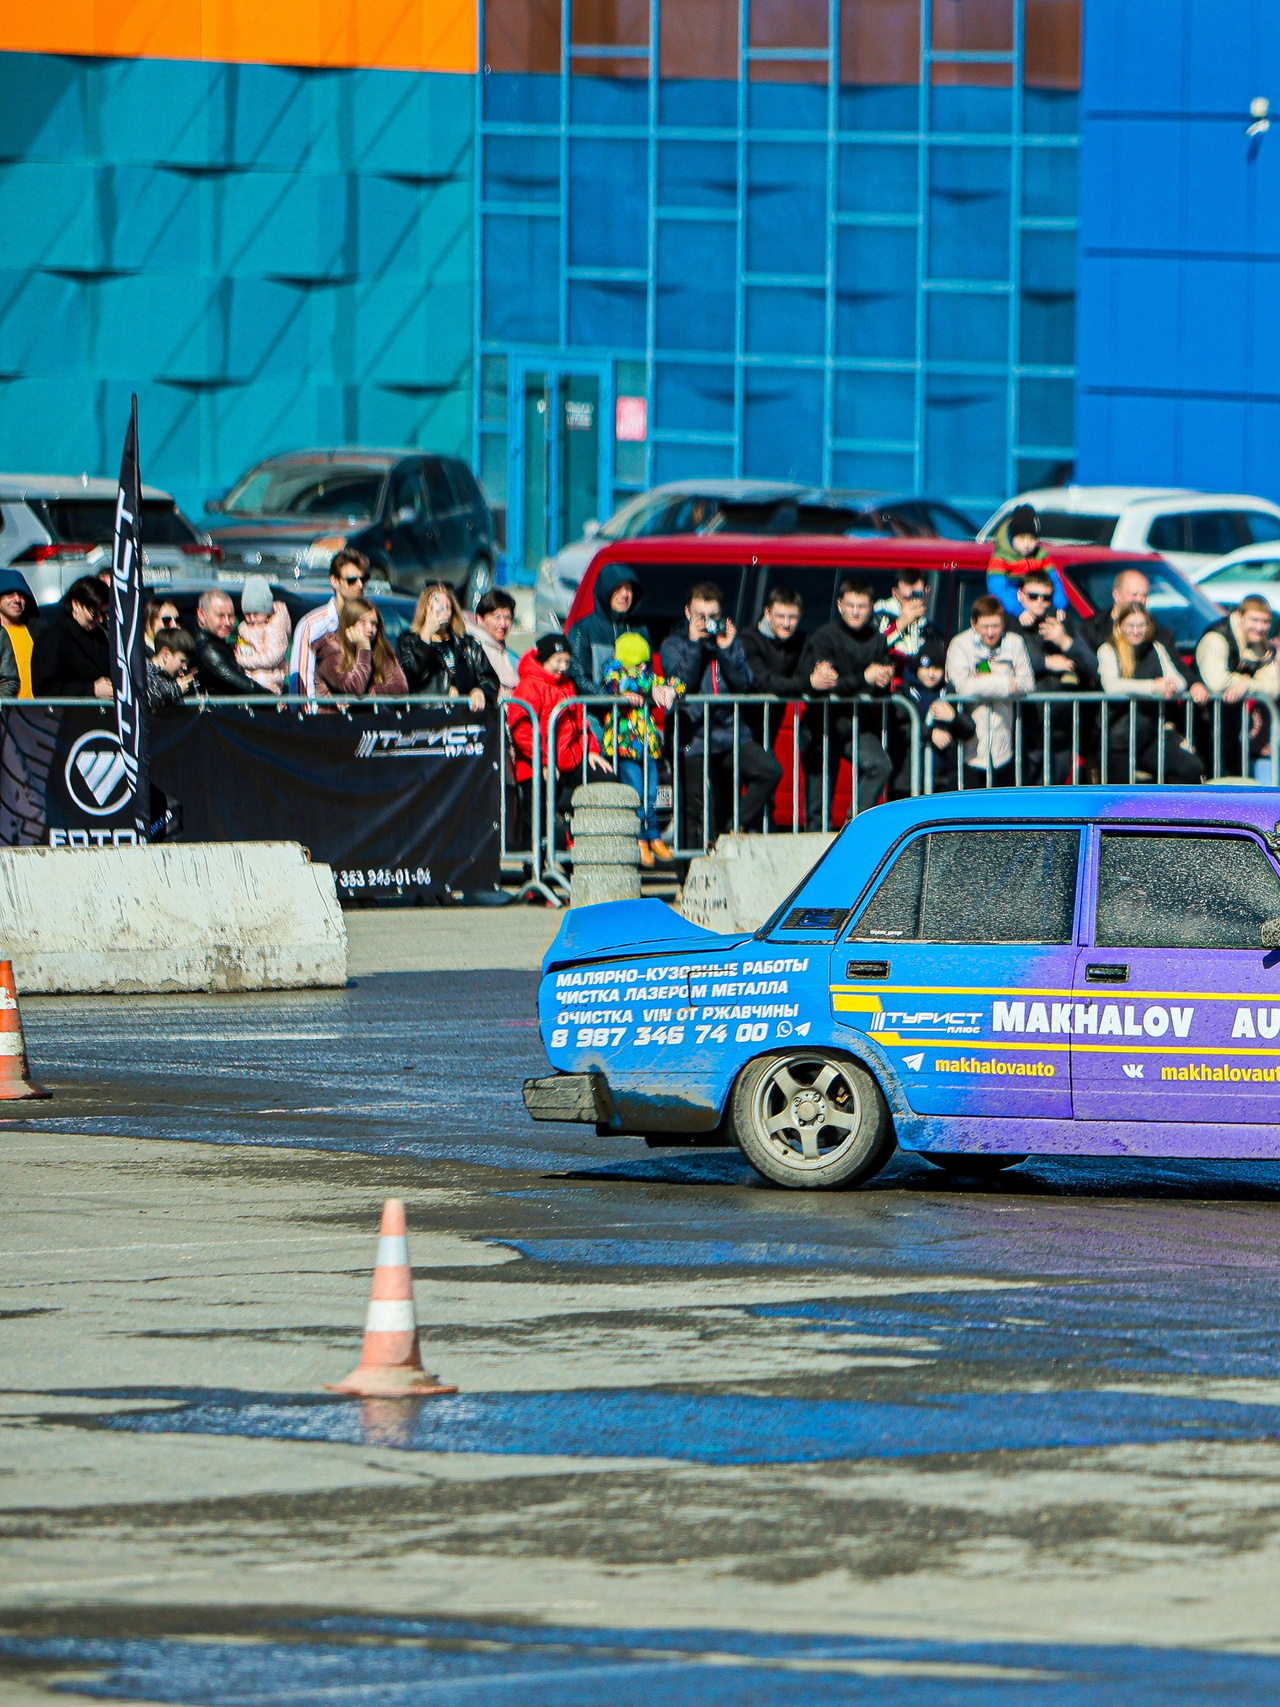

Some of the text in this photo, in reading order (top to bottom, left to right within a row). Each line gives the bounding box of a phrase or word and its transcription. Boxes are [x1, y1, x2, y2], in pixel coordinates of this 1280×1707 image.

[555, 957, 809, 987] МАЛЯРНО-КУЗОВНЫЕ РАБОТЫ
[556, 980, 789, 1005] ЧИСТКА ЛАЗЕРОМ МЕТАЛЛА
[557, 1003, 800, 1026] ОЧИСТКА VIN ОТ РЖАВЧИНЫ
[886, 1012, 983, 1025] ТУРИСТ
[992, 1000, 1195, 1038] MAKHALOV
[551, 1022, 769, 1048] 8 987 346 74 00
[946, 1026, 981, 1034] ПЛЮС
[935, 1056, 1055, 1078] makhalovauto
